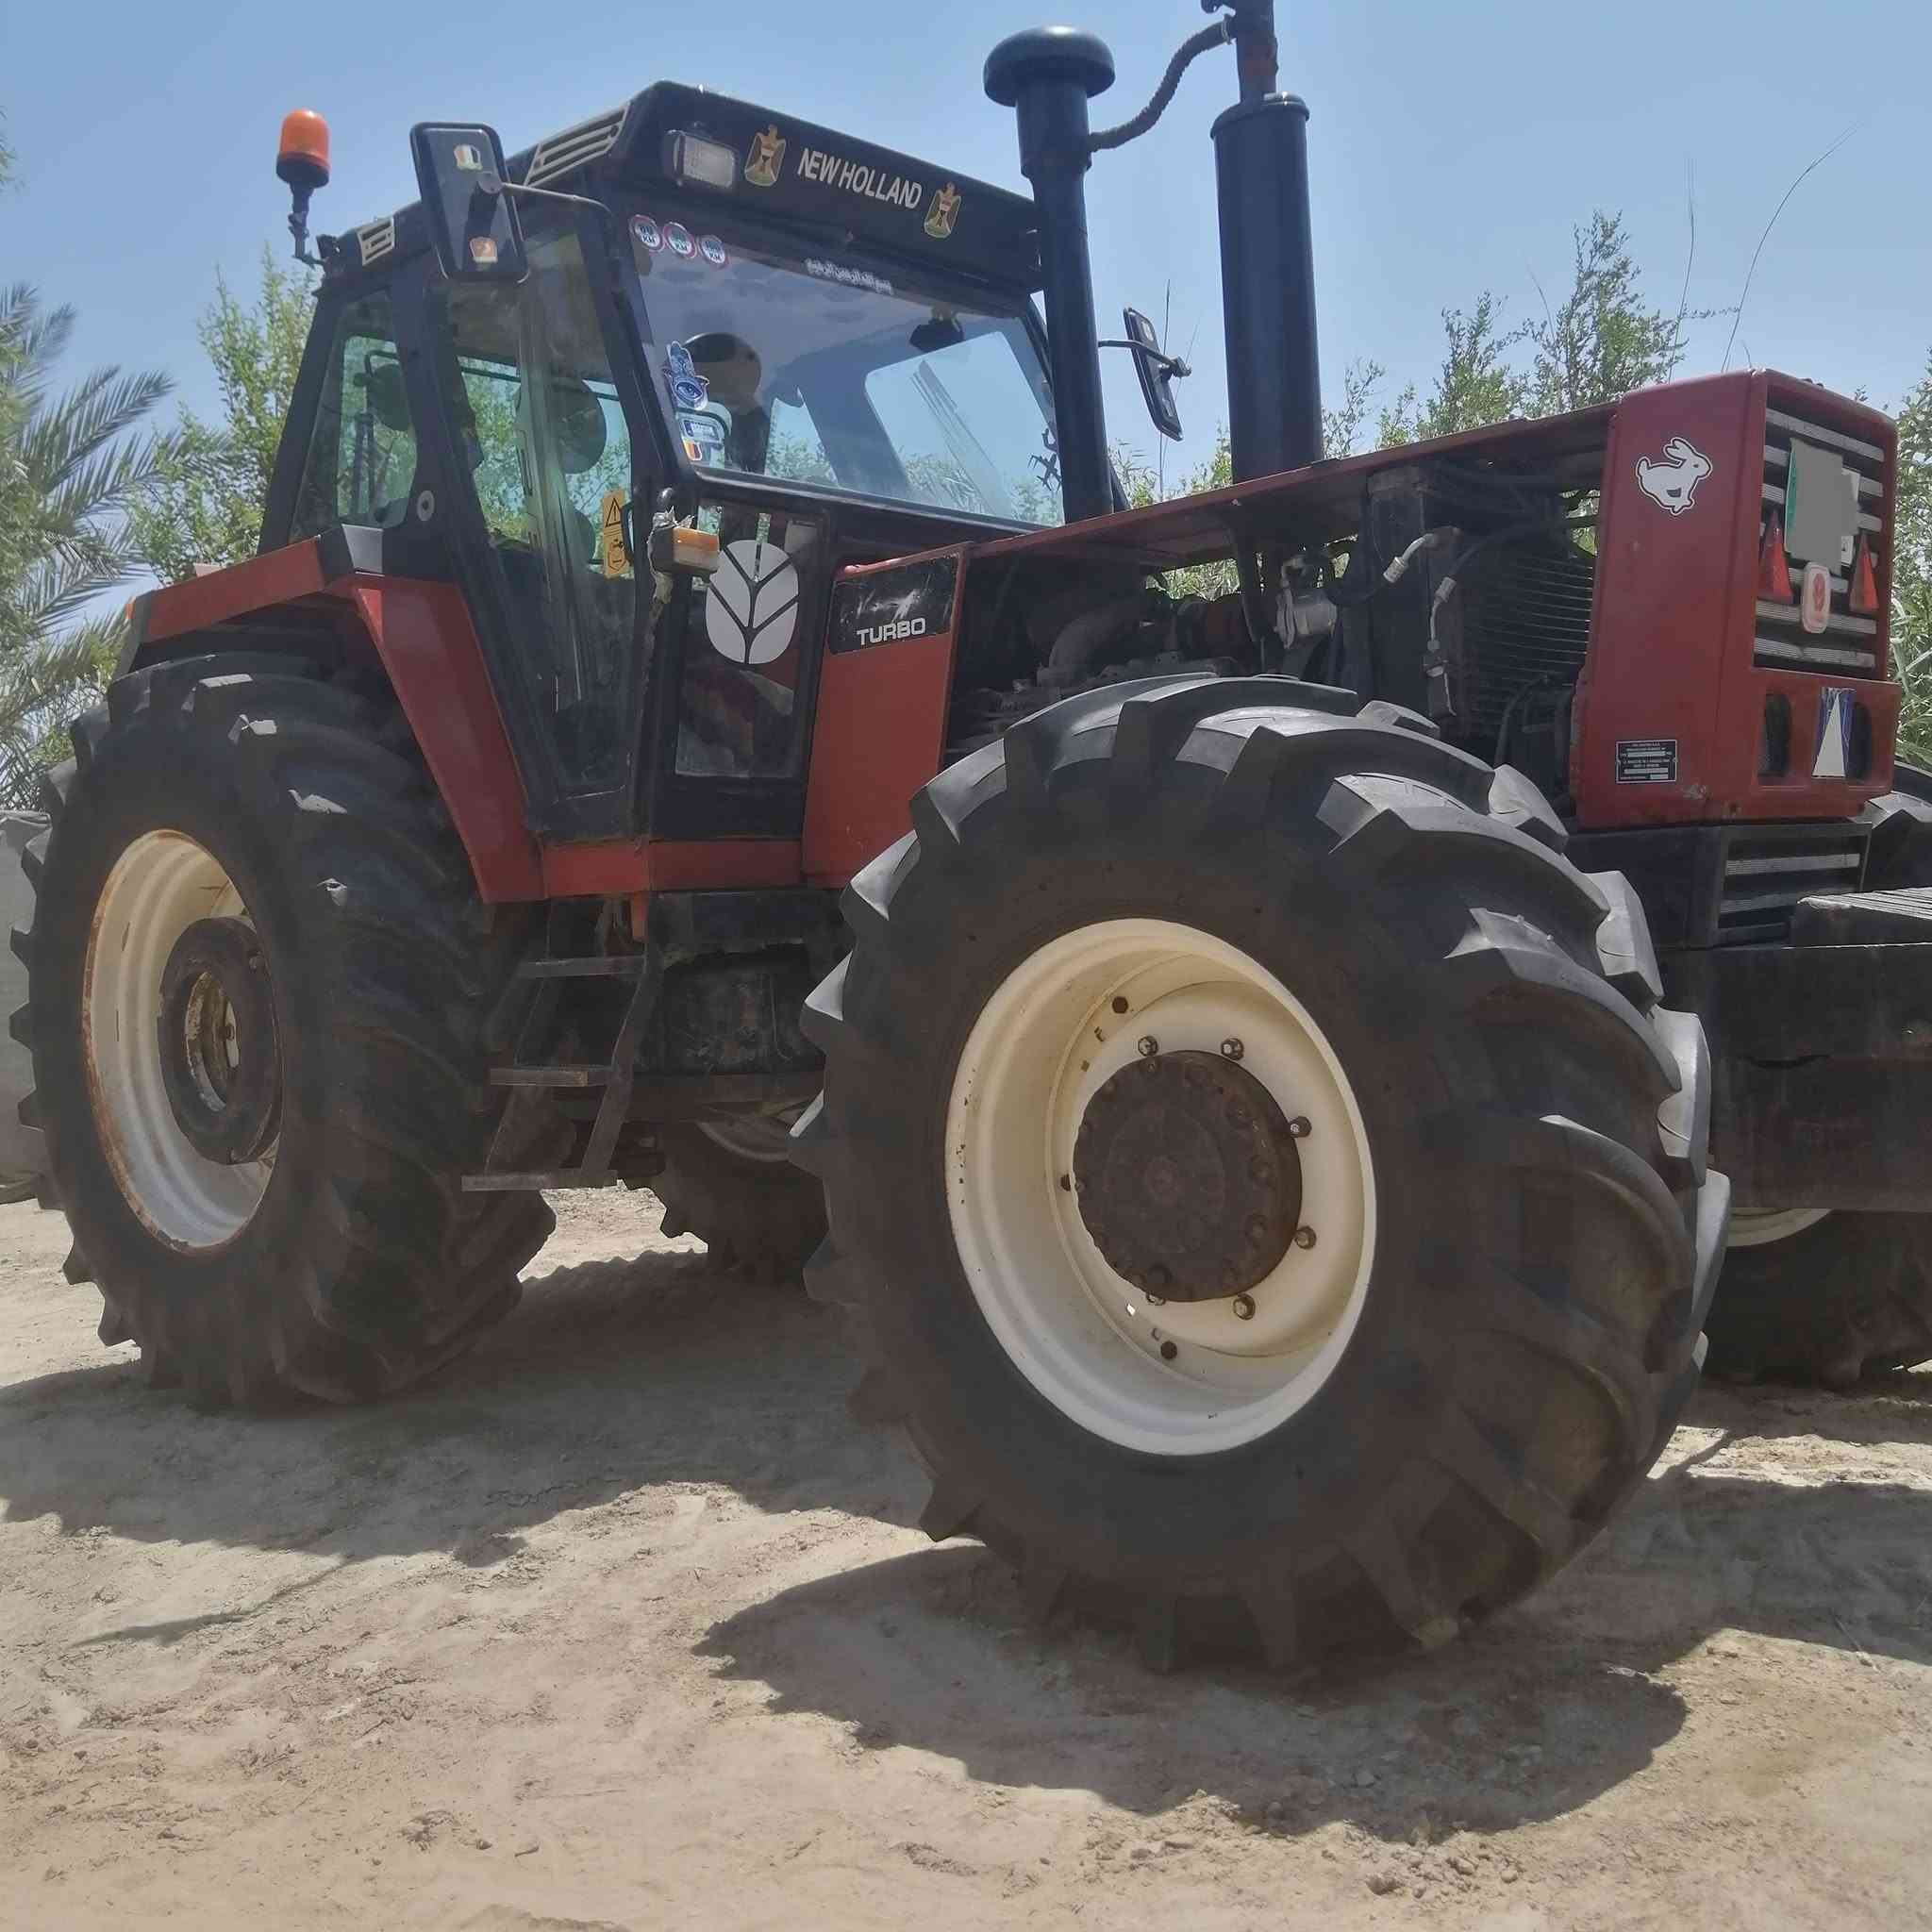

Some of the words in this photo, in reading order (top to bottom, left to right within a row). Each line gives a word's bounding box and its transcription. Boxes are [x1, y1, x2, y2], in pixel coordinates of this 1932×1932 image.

[797, 147, 841, 185] NEW
[838, 161, 923, 209] HOLLAND
[857, 617, 925, 645] TURBO
